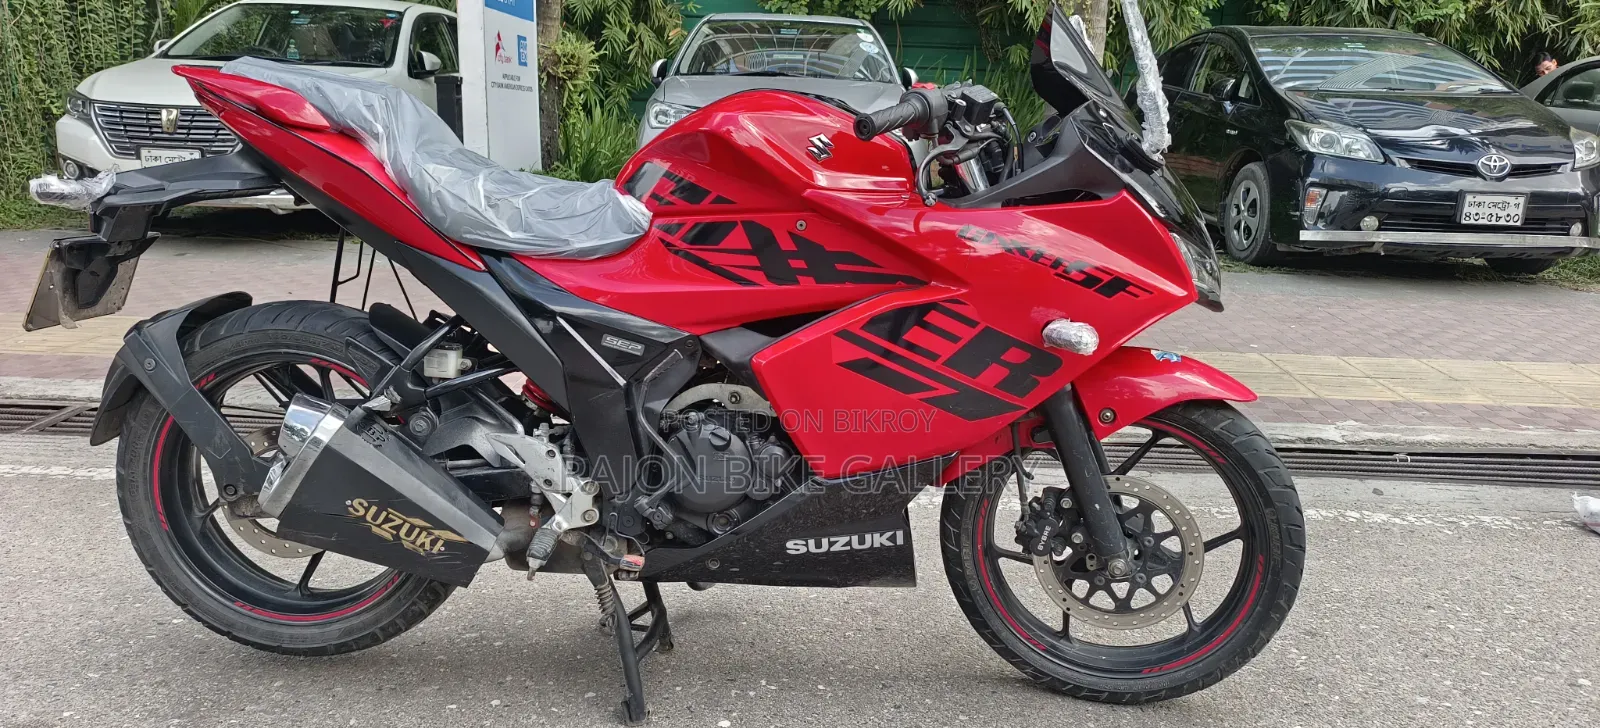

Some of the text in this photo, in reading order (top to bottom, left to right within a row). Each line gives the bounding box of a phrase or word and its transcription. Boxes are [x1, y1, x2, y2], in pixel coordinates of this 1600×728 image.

[1468, 200, 1486, 208] ঢাকা
[348, 498, 445, 554] SUZUKI
[785, 530, 904, 555] SUZUKI
